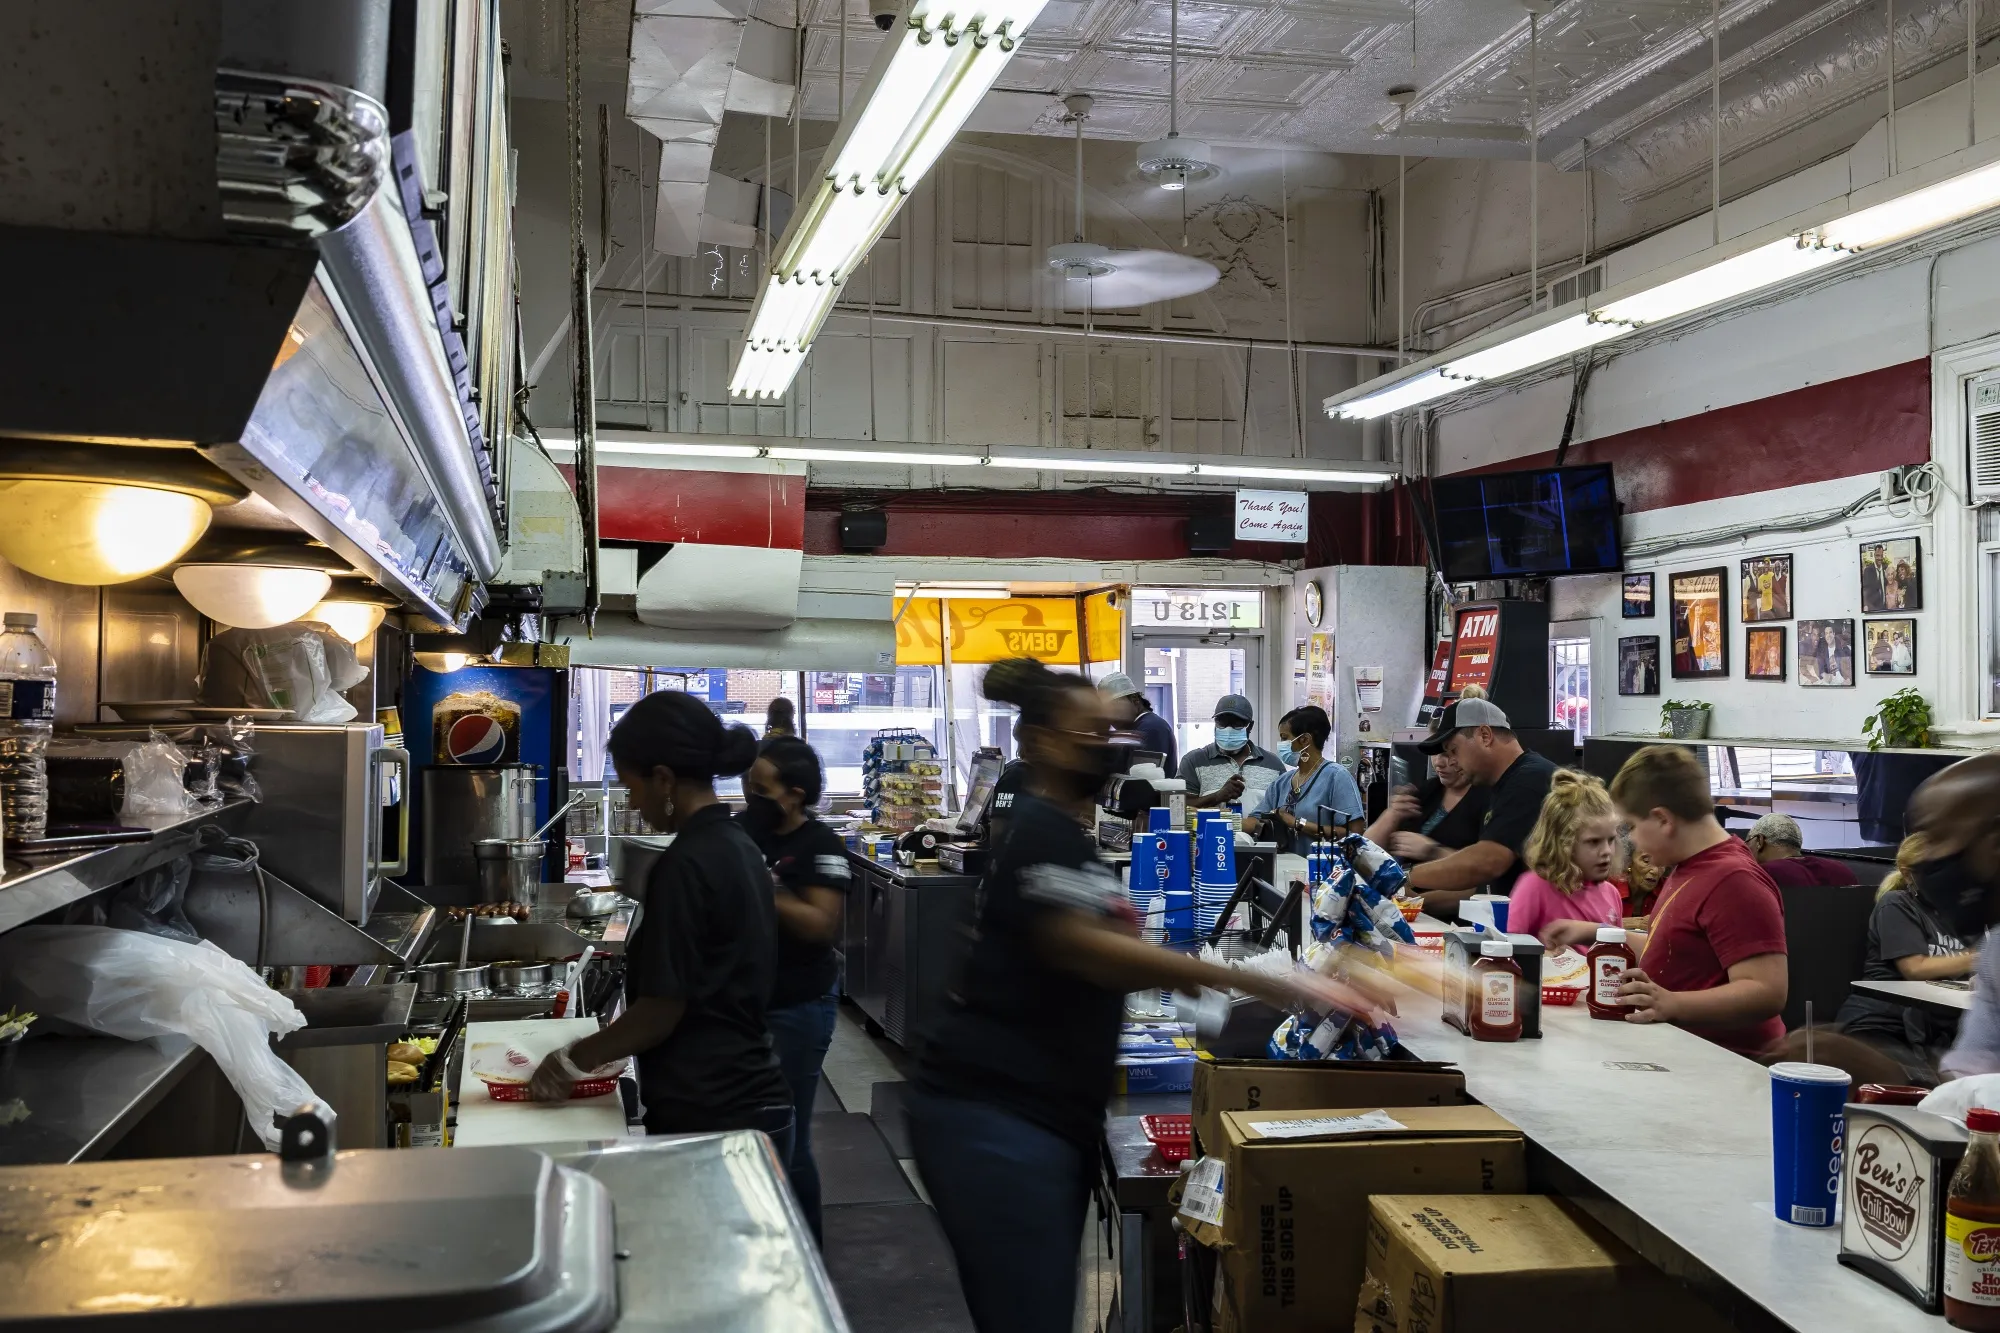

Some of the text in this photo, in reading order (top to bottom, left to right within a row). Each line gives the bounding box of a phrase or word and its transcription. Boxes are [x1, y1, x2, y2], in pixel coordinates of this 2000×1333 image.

[1240, 499, 1306, 515] Thank You!
[1240, 517, 1303, 532] Come Again
[1460, 613, 1498, 639] ATM
[1471, 654, 1489, 665] BANK
[815, 691, 833, 699] DGS
[997, 792, 1014, 800] TEAM
[1215, 836, 1227, 871] pepsi
[1129, 1067, 1154, 1077] VINYL
[1858, 1142, 1907, 1194] Ben's
[1861, 1192, 1908, 1235] Chili Bowl
[1411, 1212, 1460, 1250] DISPENSE
[1423, 1206, 1484, 1254] THIS SIDE UP
[1261, 1204, 1277, 1297] DISPENSE
[1279, 1186, 1295, 1308] THIS SIDE UP
